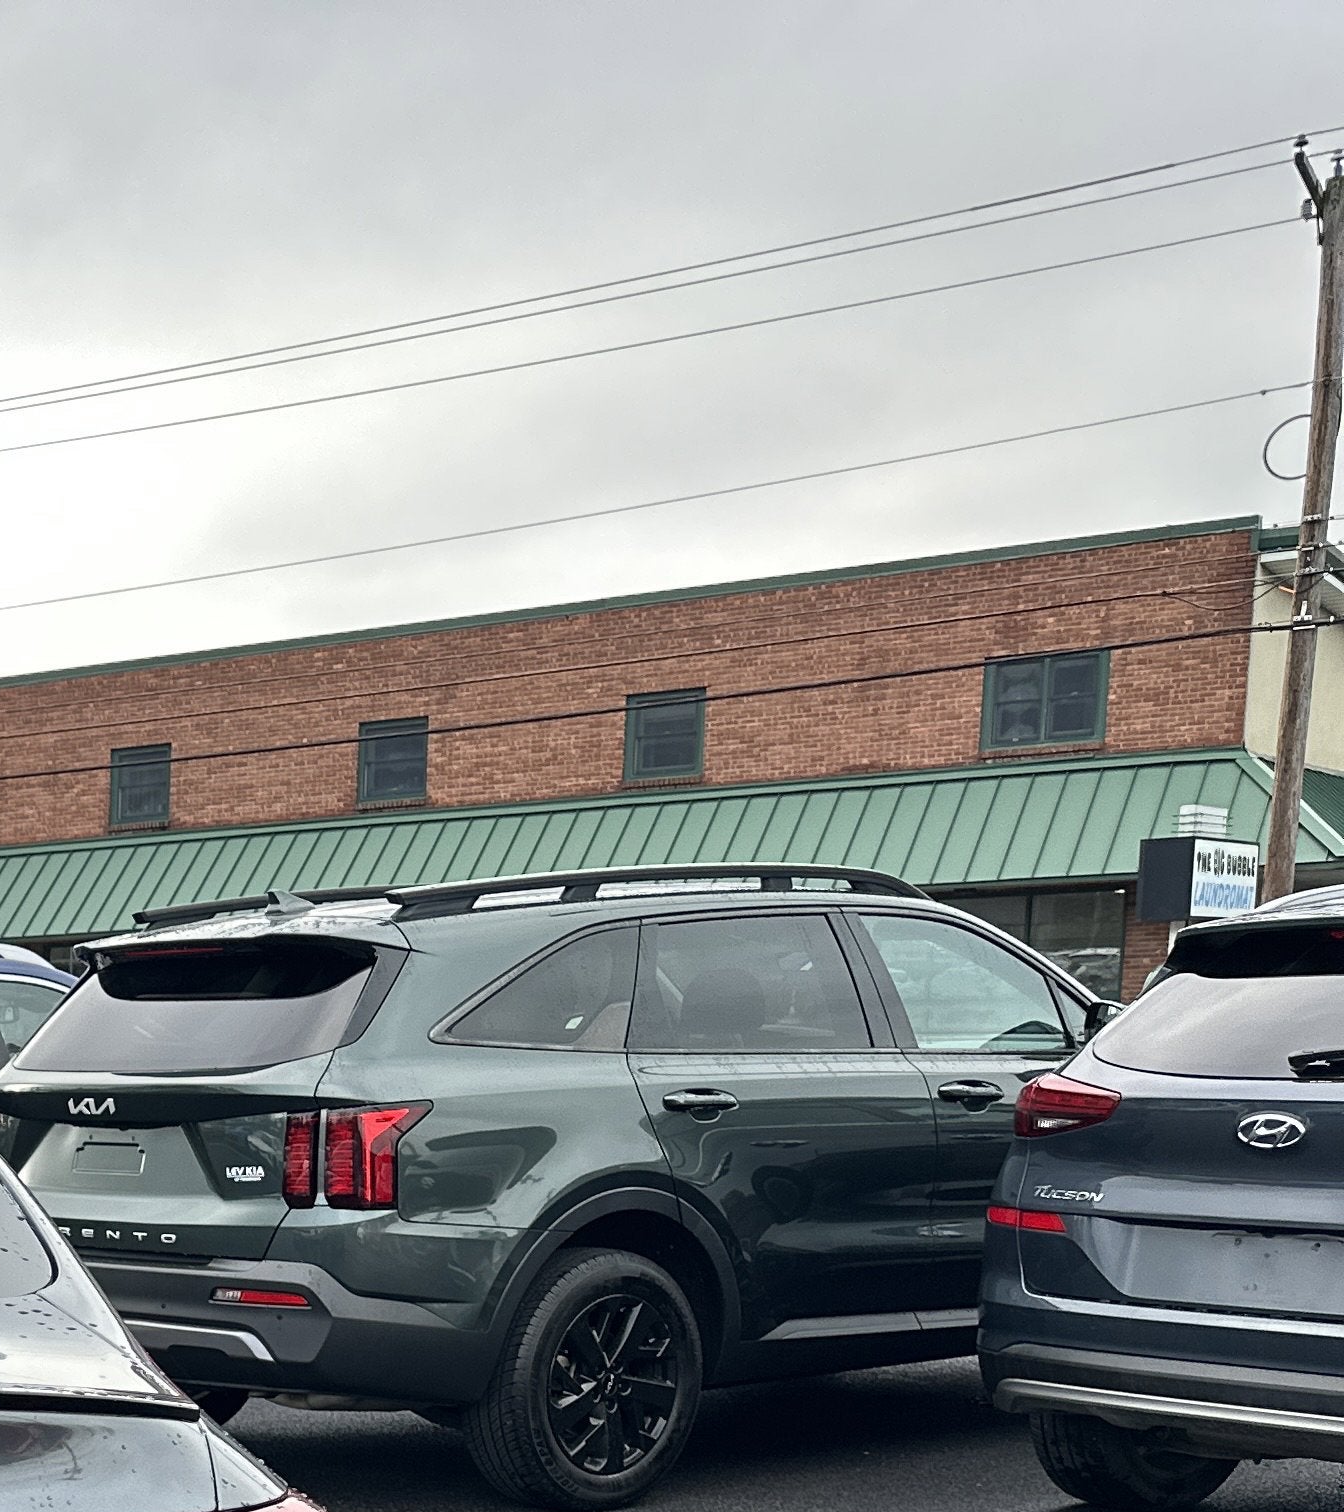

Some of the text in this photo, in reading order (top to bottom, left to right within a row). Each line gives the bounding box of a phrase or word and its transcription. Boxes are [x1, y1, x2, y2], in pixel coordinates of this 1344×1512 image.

[1197, 848, 1256, 878] THE BIG BUBBLE
[1193, 881, 1255, 910] LAUNDROMAT
[67, 1097, 116, 1115] KIA
[245, 1165, 265, 1177] KIA
[1034, 1184, 1105, 1202] TUCSON
